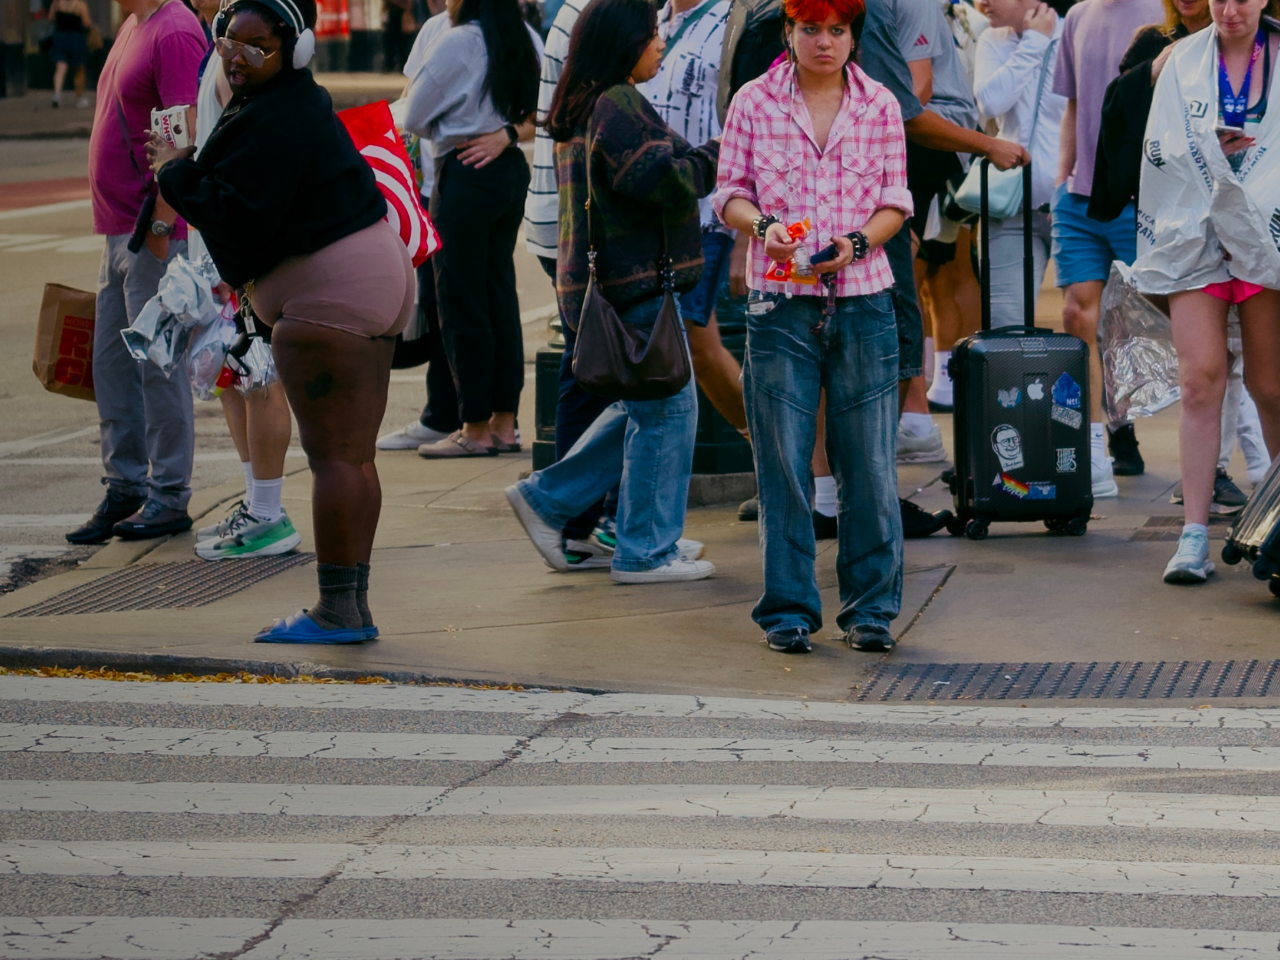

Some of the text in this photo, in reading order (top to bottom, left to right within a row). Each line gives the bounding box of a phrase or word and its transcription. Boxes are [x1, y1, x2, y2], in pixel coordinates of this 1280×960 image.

[1149, 140, 1166, 169] RUN
[65, 316, 95, 329] NORD
[58, 327, 94, 359] R
[54, 357, 94, 388] C
